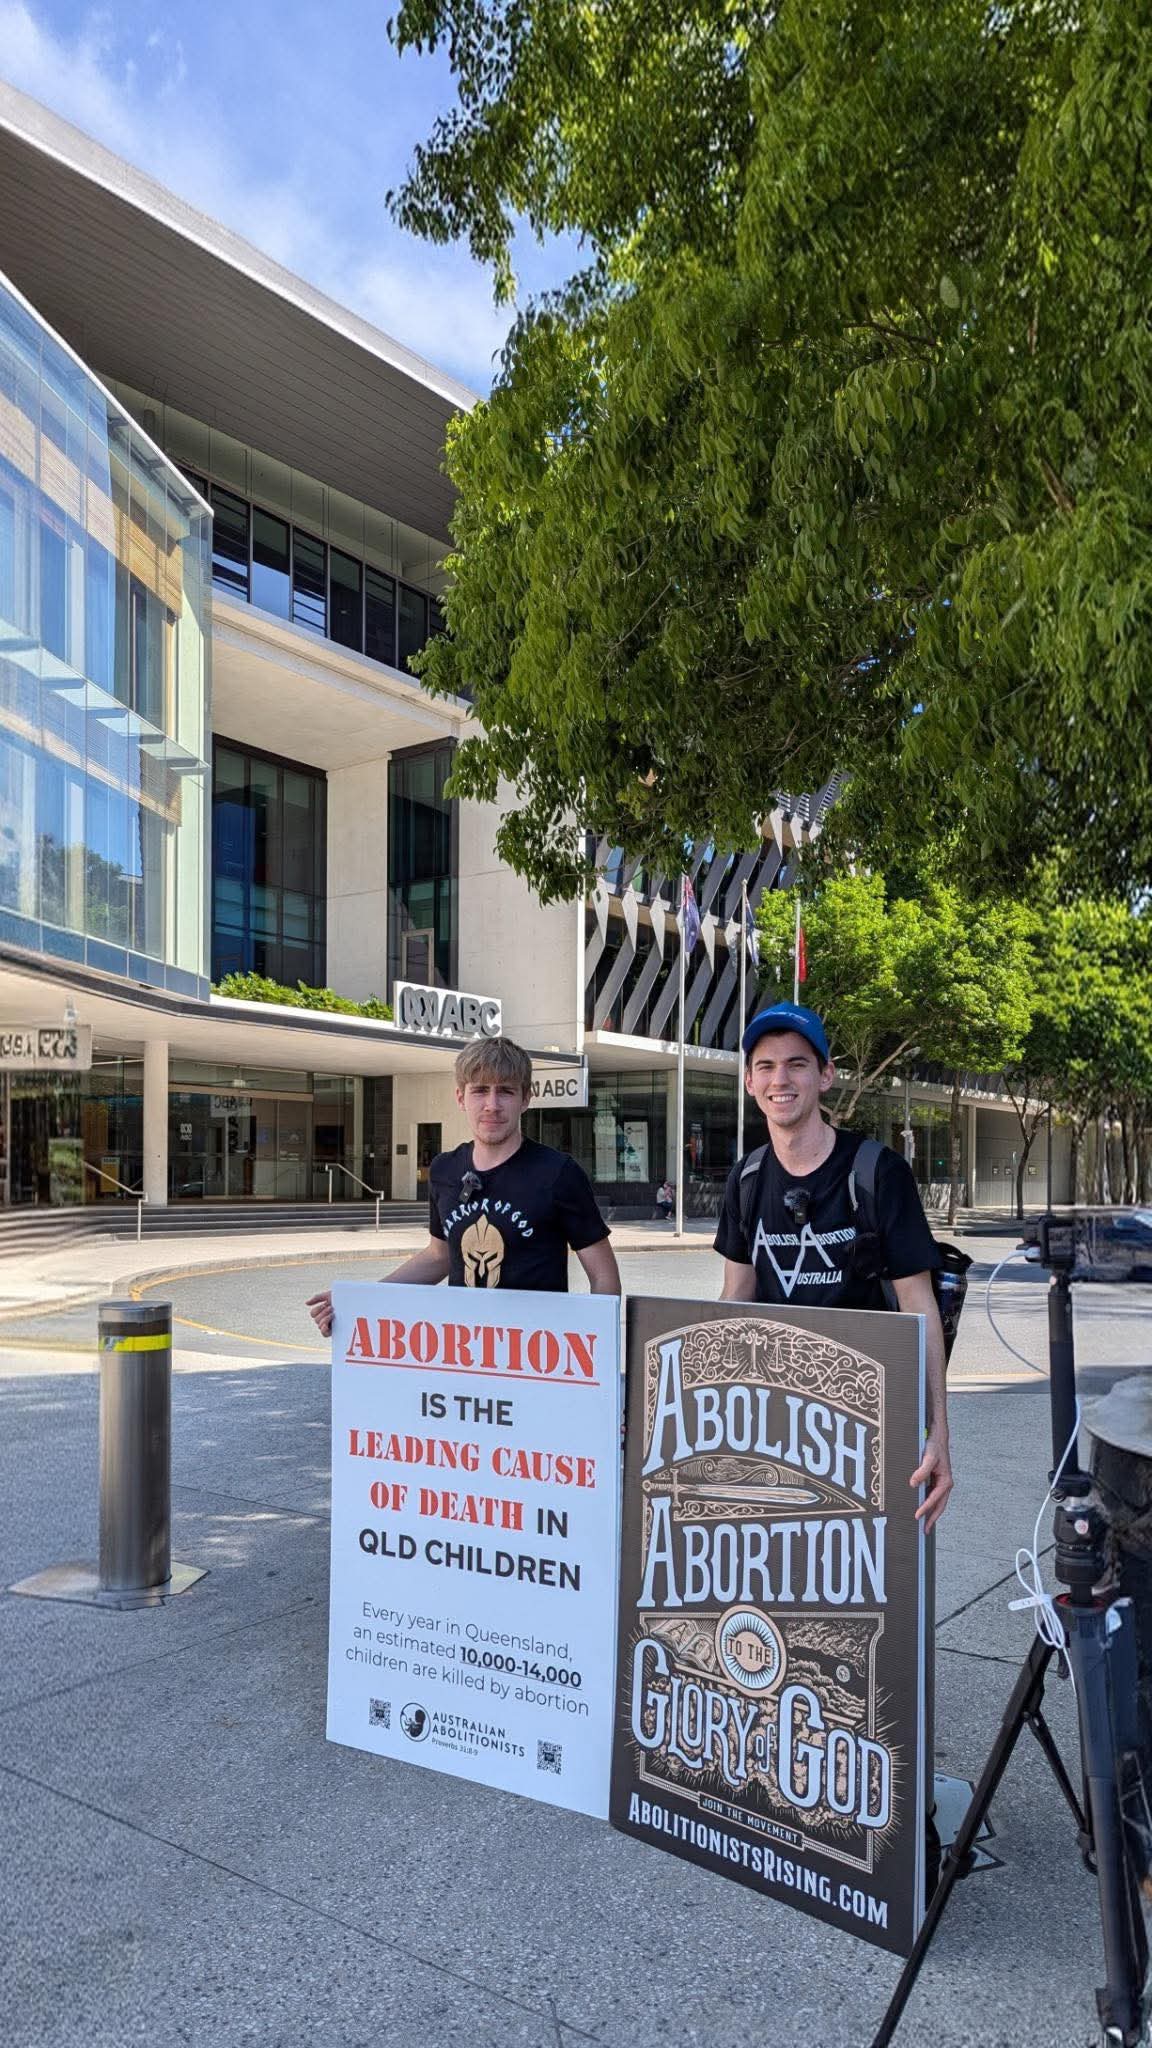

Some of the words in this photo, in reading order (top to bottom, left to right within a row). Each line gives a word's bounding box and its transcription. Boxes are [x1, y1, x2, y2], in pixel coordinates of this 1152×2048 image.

[438, 994, 501, 1037] ABC
[542, 1078, 578, 1098] ABC
[494, 1200, 511, 1215] OF
[511, 1211, 534, 1238] GOD
[778, 1269, 843, 1299] AUSTRALIA
[346, 1317, 597, 1378] ABORTION
[421, 1392, 446, 1418] IS
[453, 1396, 514, 1427] THE
[641, 1339, 867, 1499] ABOLISH
[349, 1429, 480, 1472] LEADING
[491, 1447, 596, 1488] CAUSE
[370, 1481, 408, 1511] OF
[419, 1487, 524, 1531] DEATH
[536, 1508, 568, 1538] IN
[358, 1528, 417, 1560] QLD
[424, 1539, 581, 1591] CHILDREN
[636, 1496, 888, 1607] ABORTION
[353, 1626, 372, 1640] an
[376, 1631, 456, 1659] estimated
[460, 1646, 582, 1688] 10,000-14,000
[363, 1601, 404, 1627] Every
[407, 1614, 442, 1631] year
[446, 1617, 460, 1636] in
[465, 1623, 573, 1662] Queensland,
[728, 1637, 742, 1656] TO
[747, 1643, 772, 1665] THE
[345, 1646, 408, 1672] children
[412, 1663, 437, 1679] are
[442, 1665, 485, 1691] killed
[490, 1677, 510, 1700] by
[514, 1685, 589, 1717] abortion
[431, 1737, 458, 1751] Proverbs
[432, 1711, 506, 1738] AUSTRALIAN
[432, 1724, 525, 1757] ABOLITIONISTS
[631, 1638, 759, 1787] GLORY
[778, 1684, 891, 1828] GOD
[702, 1798, 723, 1814] JOIN
[727, 1807, 743, 1821] THE
[747, 1815, 798, 1843] MOVEMENT
